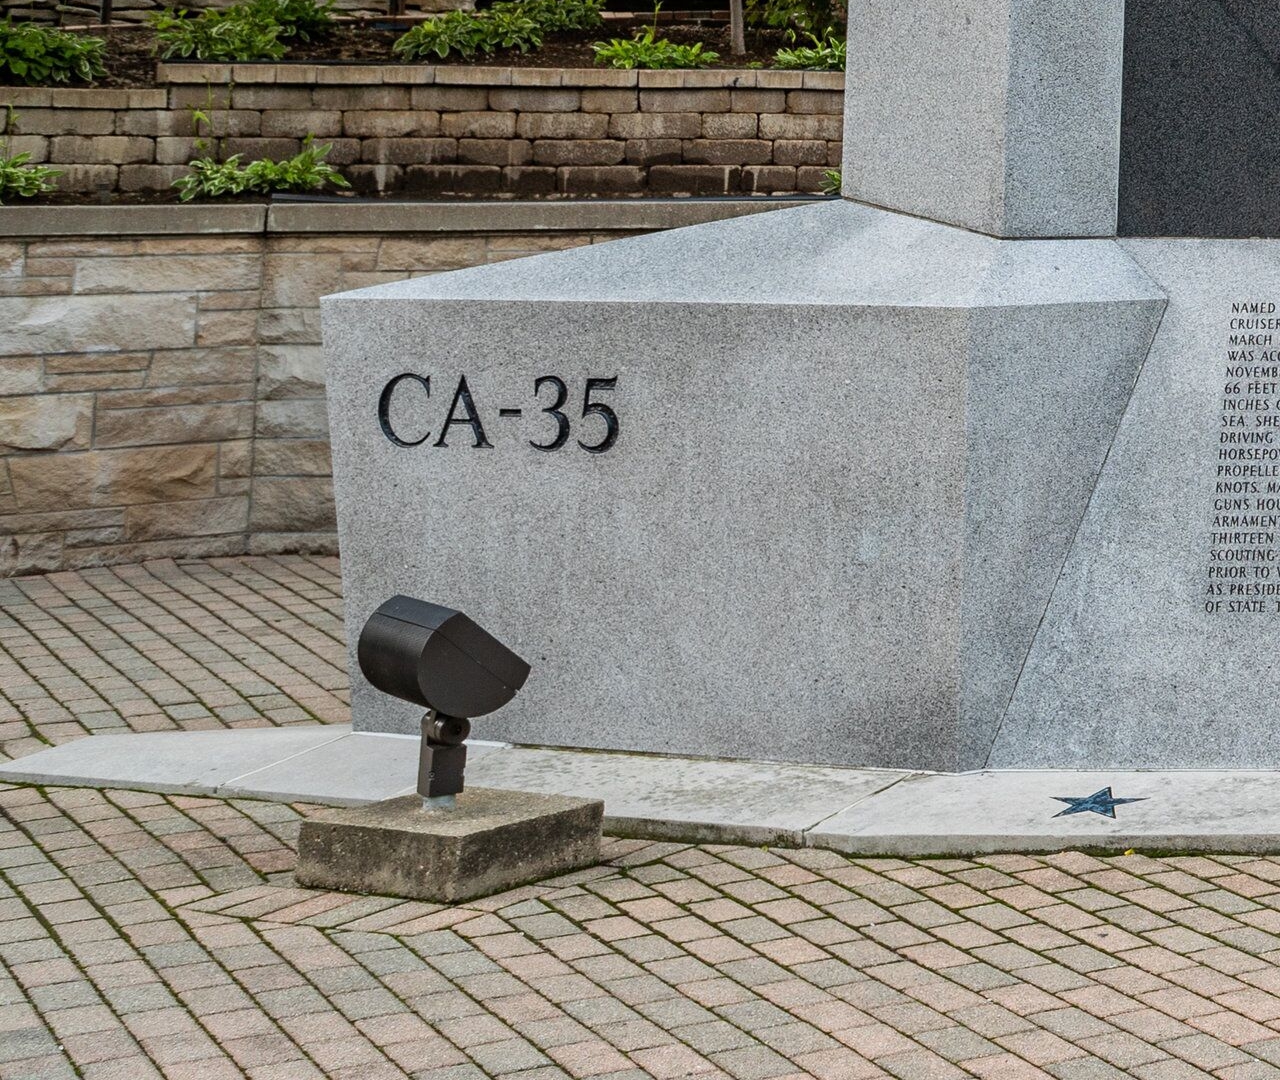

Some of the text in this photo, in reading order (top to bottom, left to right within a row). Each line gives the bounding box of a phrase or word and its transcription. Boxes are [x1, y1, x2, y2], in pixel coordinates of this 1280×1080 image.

[1228, 350, 1255, 363] WAS
[377, 371, 620, 454] CA-35
[1256, 414, 1280, 427] SHE
[1210, 531, 1274, 544] THIRTEEN
[1207, 582, 1223, 595] AS
